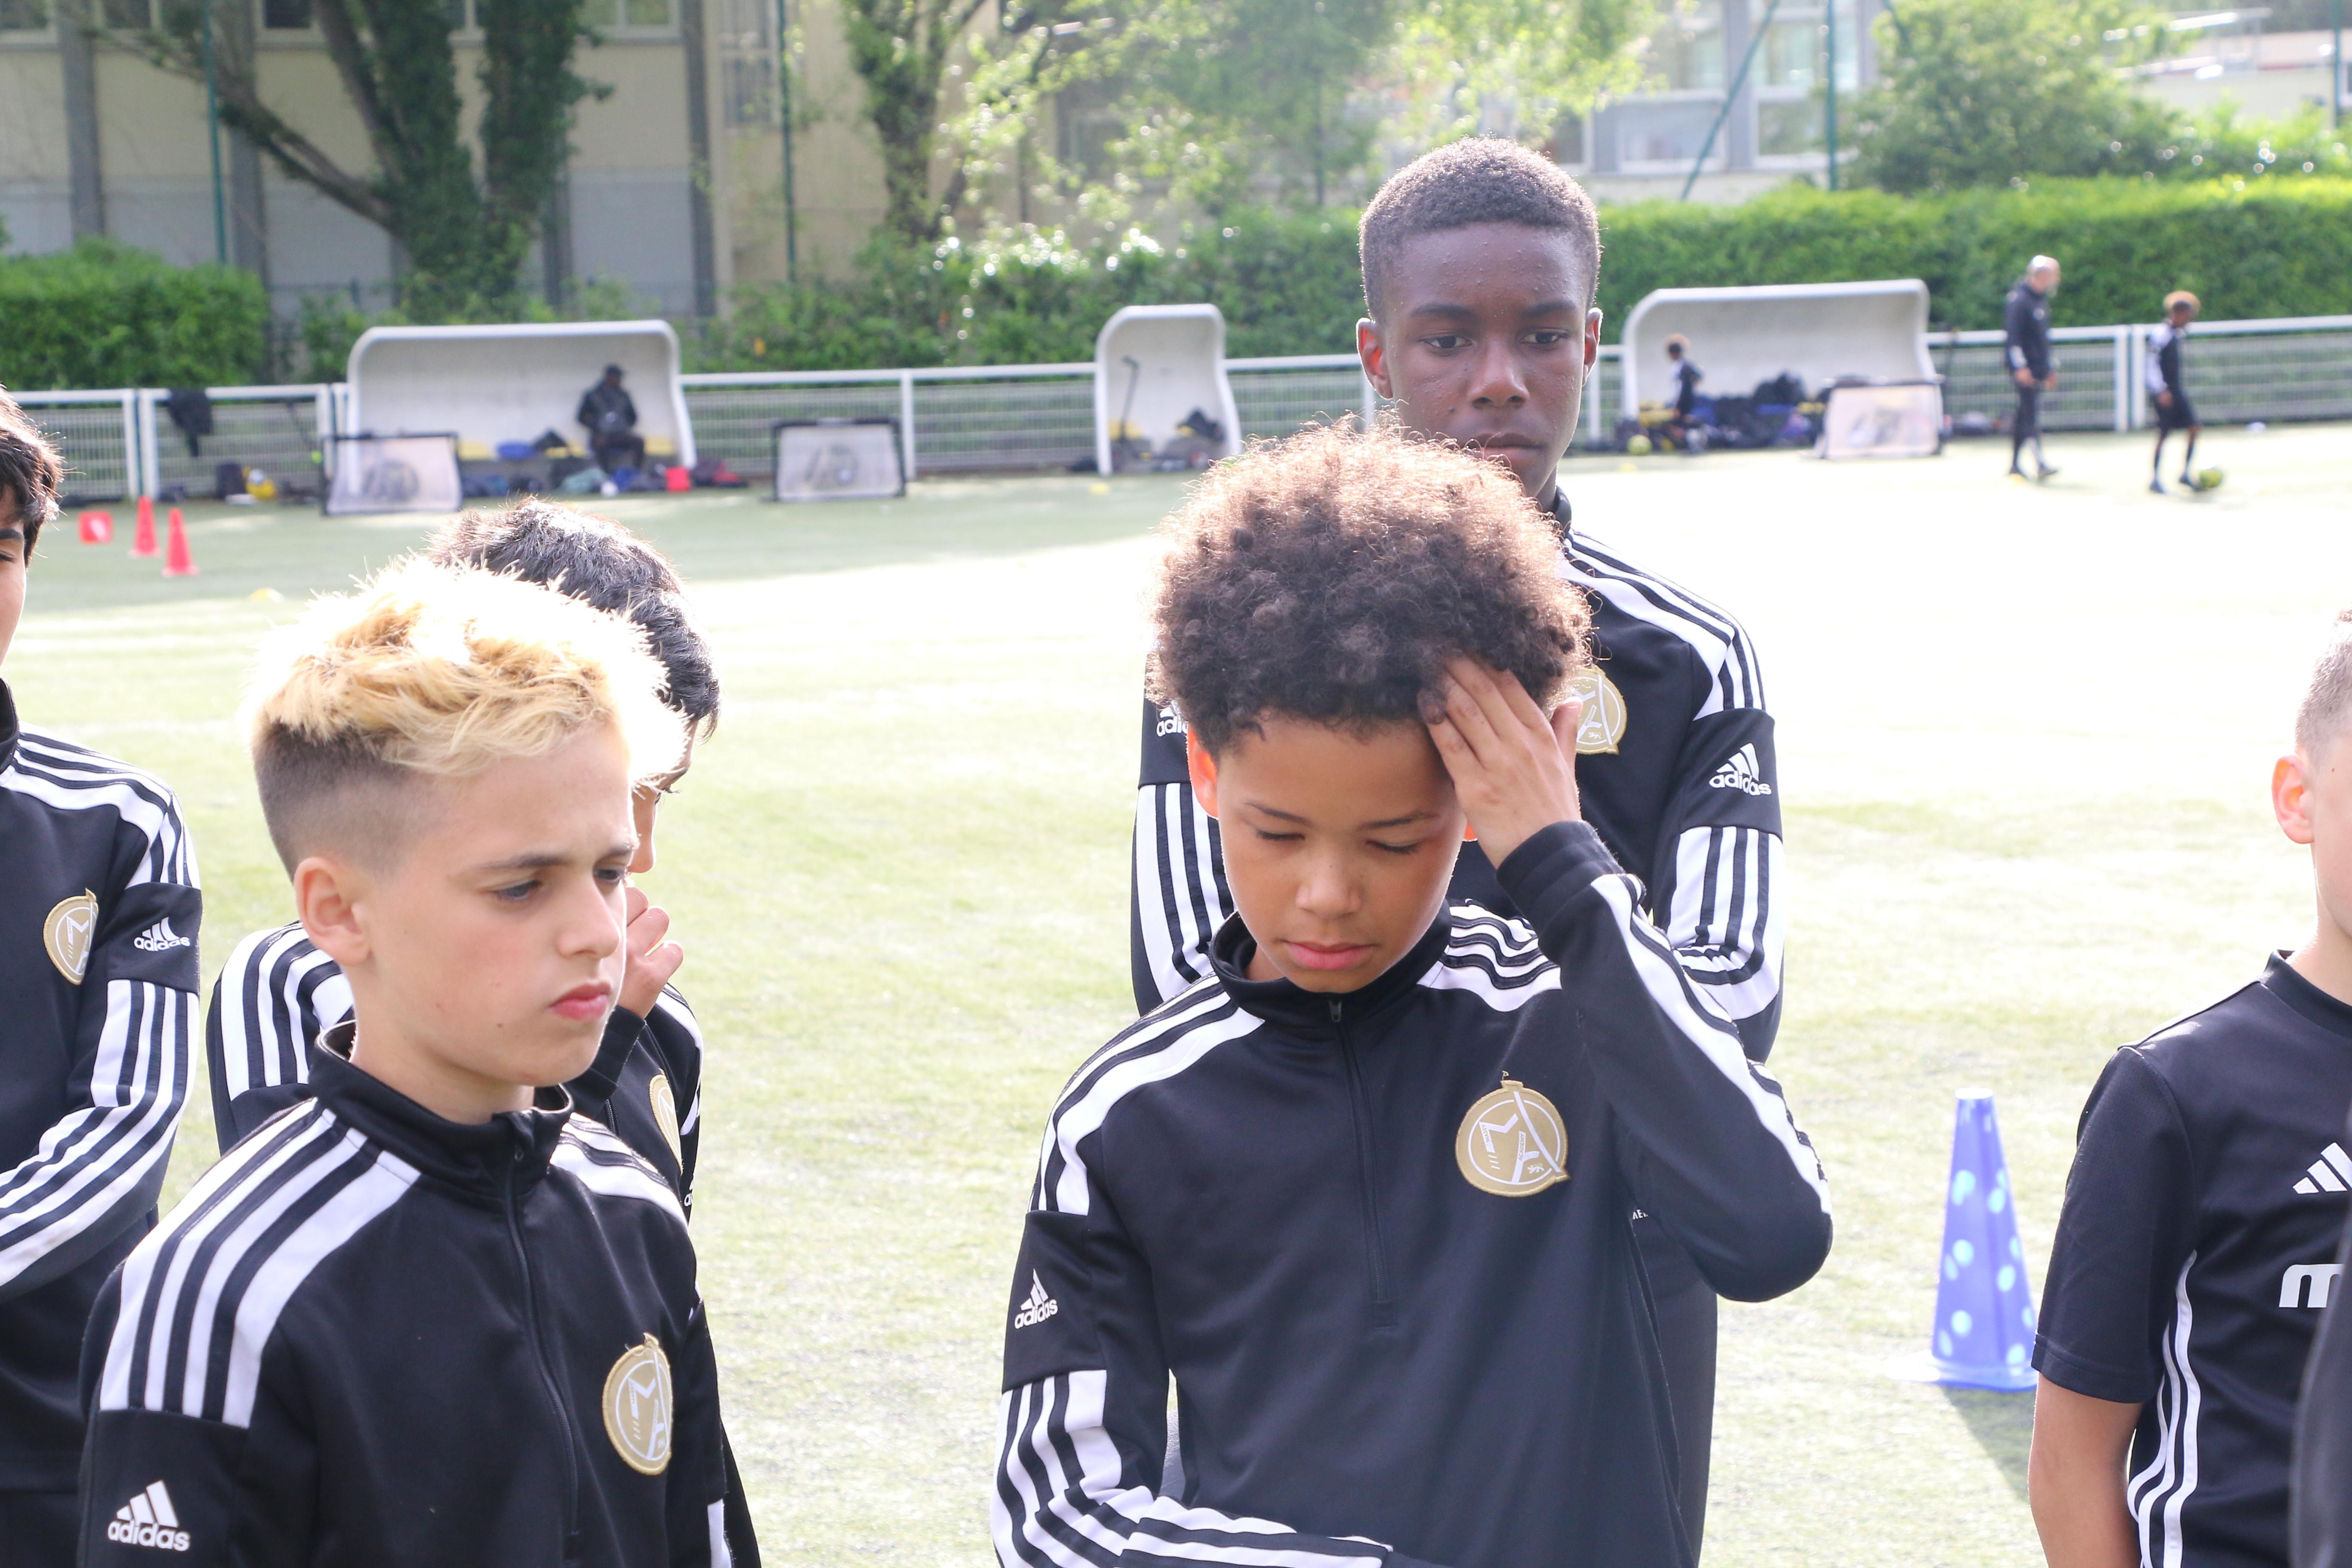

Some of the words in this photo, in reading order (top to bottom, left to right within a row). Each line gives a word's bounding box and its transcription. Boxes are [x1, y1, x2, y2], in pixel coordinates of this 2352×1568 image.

[1709, 770, 1772, 795] adidas
[134, 936, 190, 951] adidas
[1482, 1125, 1490, 1142] MASSY
[1014, 1299, 1058, 1329] adidas
[108, 1519, 191, 1551] adidas
